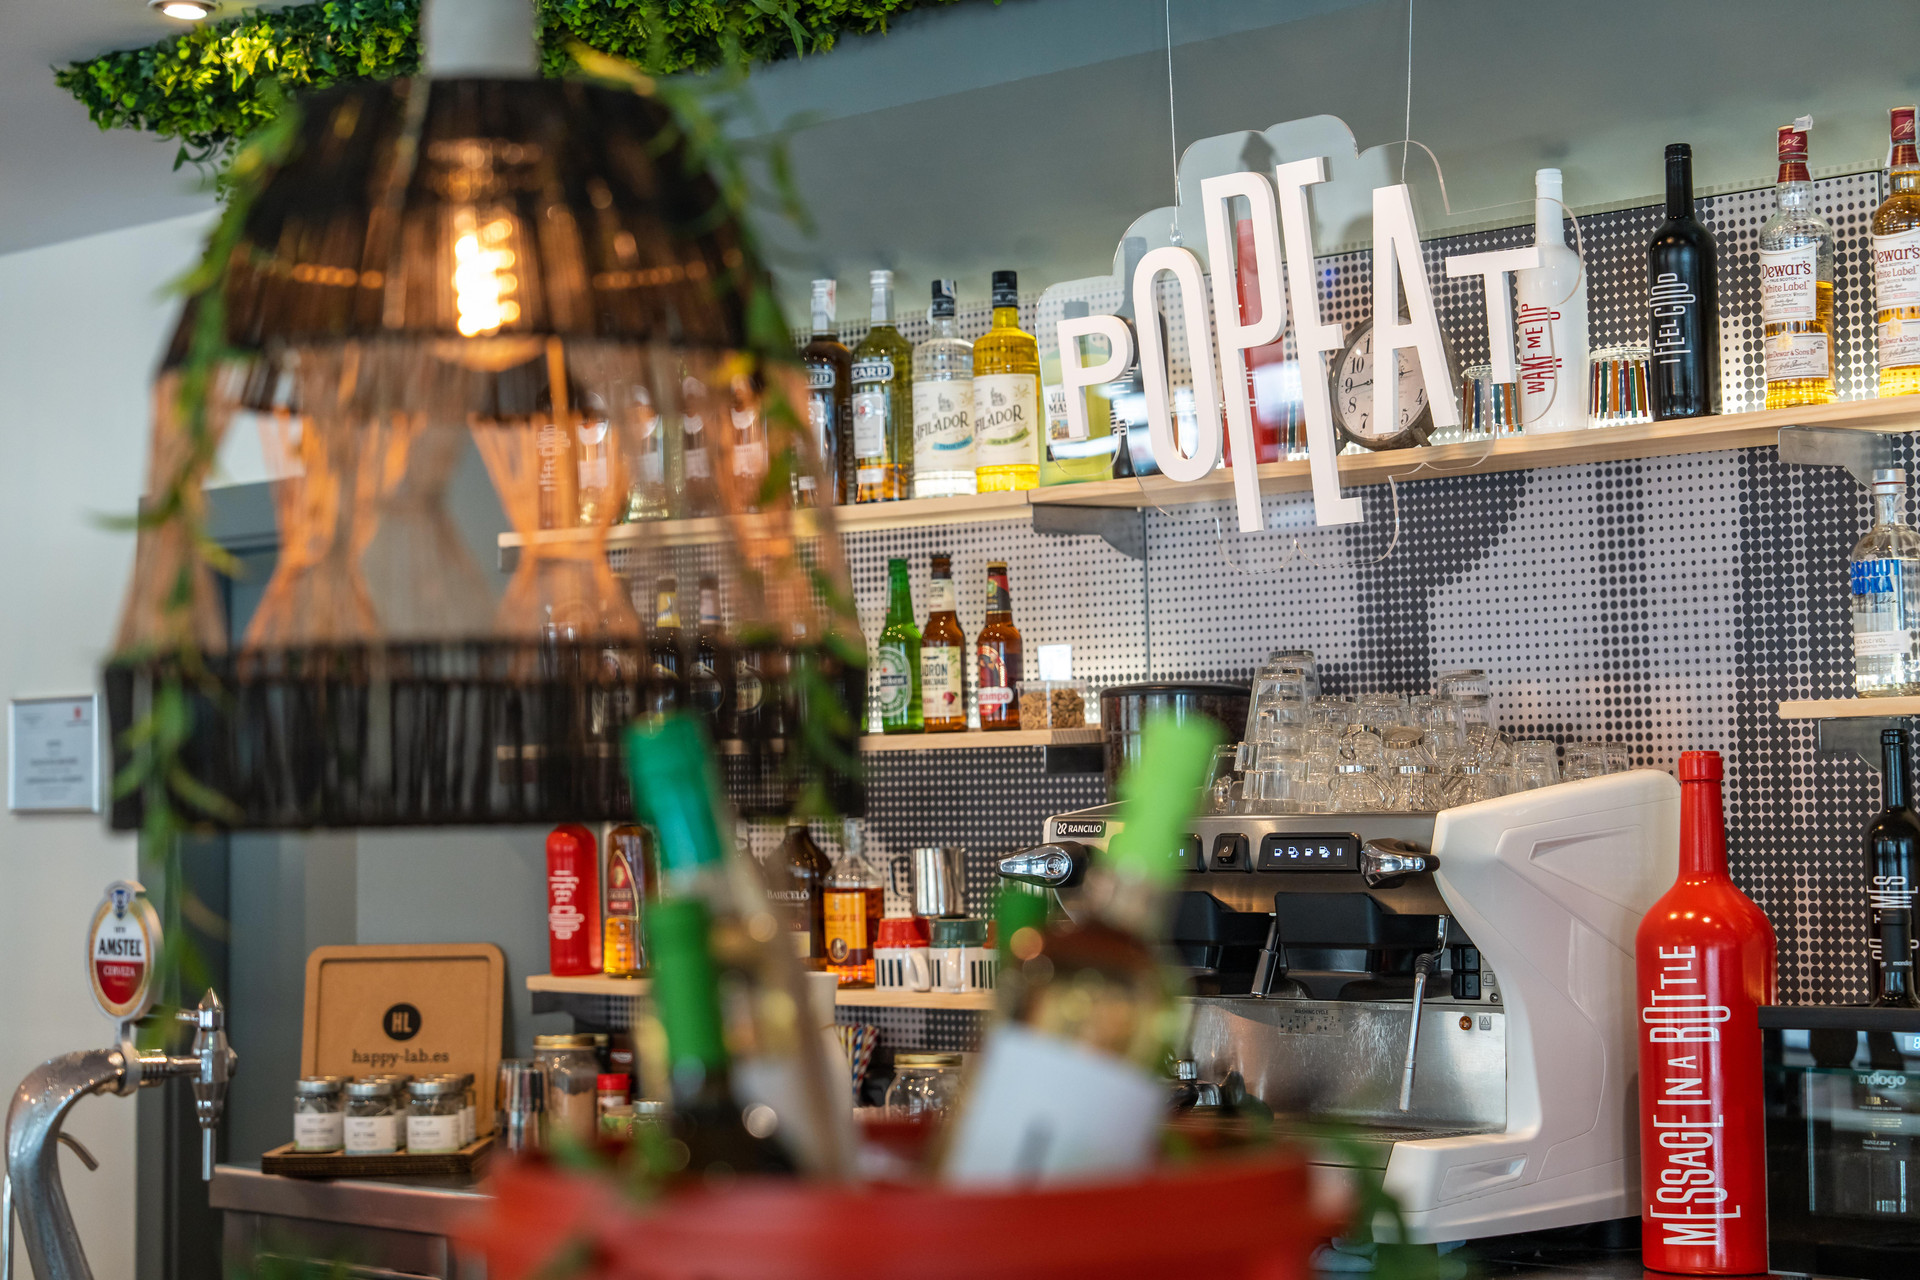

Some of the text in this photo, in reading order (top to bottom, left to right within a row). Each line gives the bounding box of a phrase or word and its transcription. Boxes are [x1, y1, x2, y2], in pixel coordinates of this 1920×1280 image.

[1762, 260, 1811, 279] Dewar's
[1648, 272, 1696, 318] GOOD
[1783, 280, 1808, 292] Label
[1057, 156, 1543, 533] POPEAT
[1525, 326, 1544, 348] ME
[1653, 319, 1691, 357] FEEL
[853, 366, 889, 379] CARD
[1350, 356, 1365, 375] 10
[1344, 377, 1353, 395] 9
[1347, 396, 1357, 414] 8
[975, 404, 1024, 435] FILADOR
[1360, 412, 1369, 430] 7
[1068, 824, 1102, 833] RANCILIO
[98, 938, 142, 957] AMSTEL
[352, 1048, 449, 1068] happy-lab.es
[1642, 945, 1741, 1246] MESSAGE IN A BOTTLE
